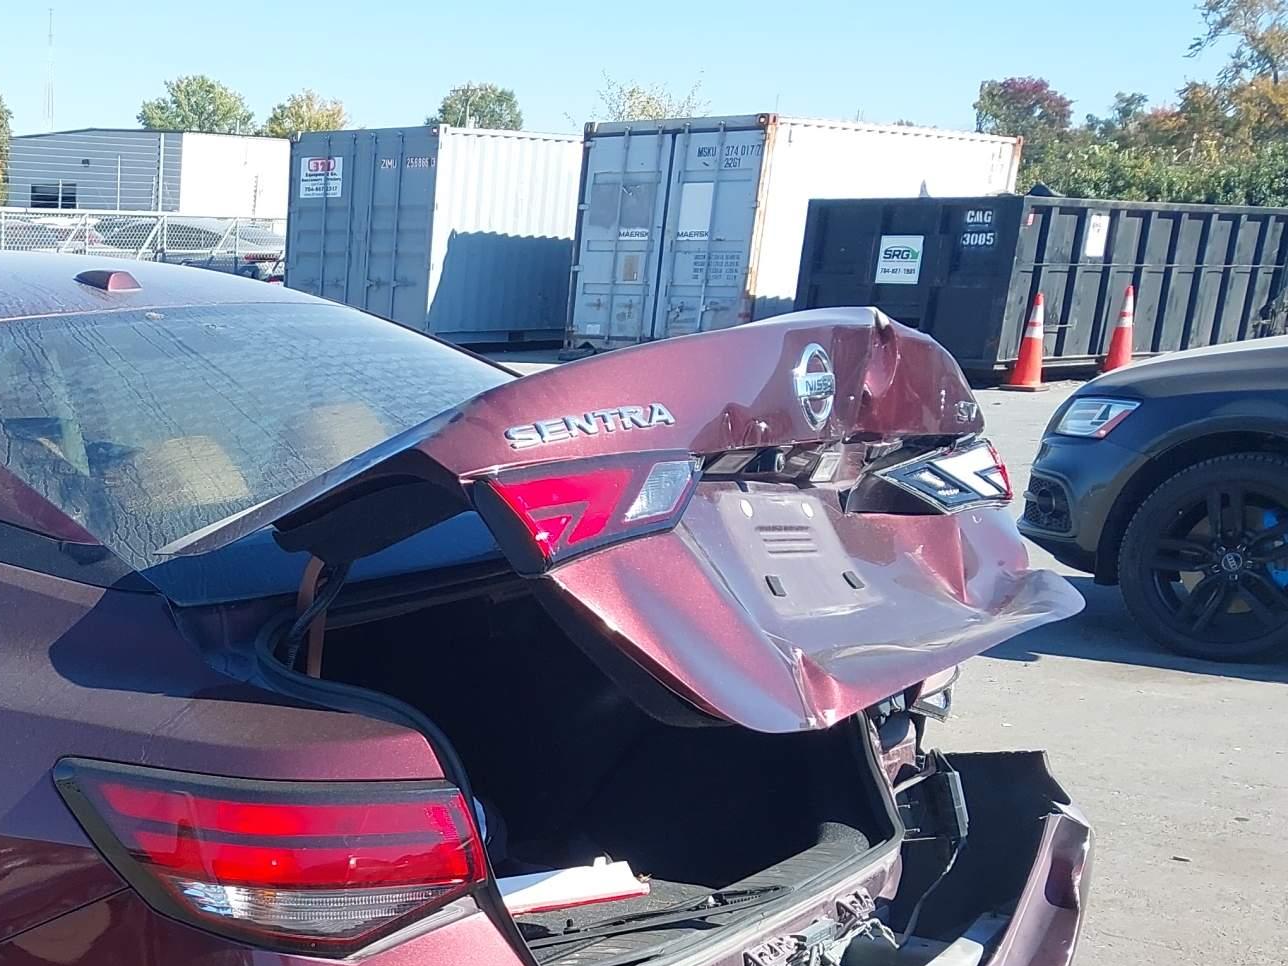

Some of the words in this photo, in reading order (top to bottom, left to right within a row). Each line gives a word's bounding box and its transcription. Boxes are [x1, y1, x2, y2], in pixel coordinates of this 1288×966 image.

[618, 230, 650, 239] MAERSK
[676, 230, 710, 239] MAERSK
[882, 249, 911, 260] SRG
[503, 402, 676, 450] SENTRA
